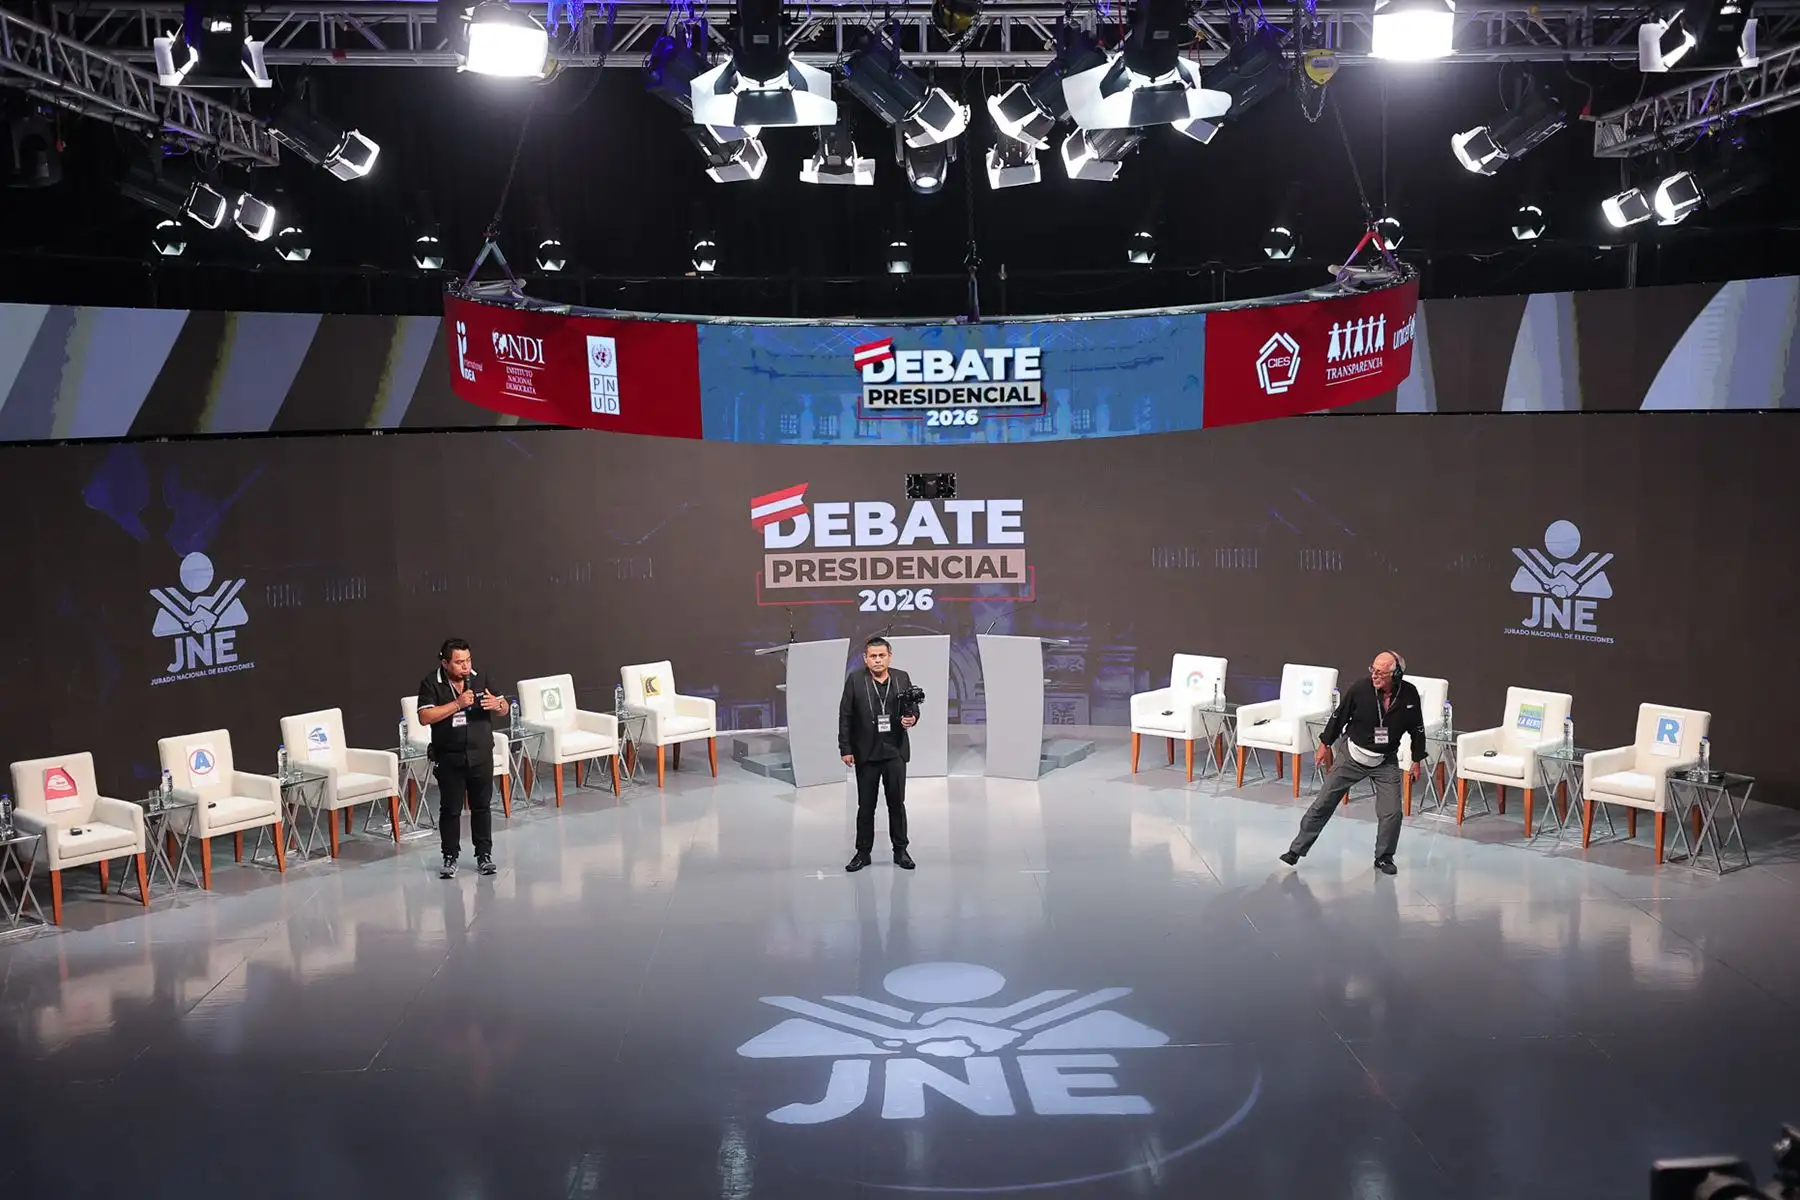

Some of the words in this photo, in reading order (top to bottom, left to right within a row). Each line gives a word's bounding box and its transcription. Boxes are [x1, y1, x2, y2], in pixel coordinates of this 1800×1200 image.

[507, 334, 545, 364] NDI
[862, 347, 1042, 383] DEBATE
[1267, 356, 1291, 368] CIES
[1326, 357, 1383, 380] TRANSPARENCIA
[868, 386, 1036, 405] PRESIDENCIAL
[926, 409, 979, 426] 2026
[764, 499, 1025, 549] DEBATE
[772, 555, 1019, 583] PRESIDENCIAL
[858, 588, 934, 611] 2026
[1521, 596, 1598, 633] JNE
[1503, 628, 1530, 636] JURADO
[1531, 630, 1564, 639] NACIONAL
[1574, 634, 1615, 644] ELECCIONES
[167, 630, 238, 673] JNE
[151, 675, 176, 686] JURADO
[176, 669, 208, 681] NACIONAL
[208, 667, 217, 675] DE
[217, 662, 255, 674] ELECCIONES
[1656, 718, 1680, 744] R
[194, 751, 211, 770] A
[765, 1054, 1155, 1124] JNE
